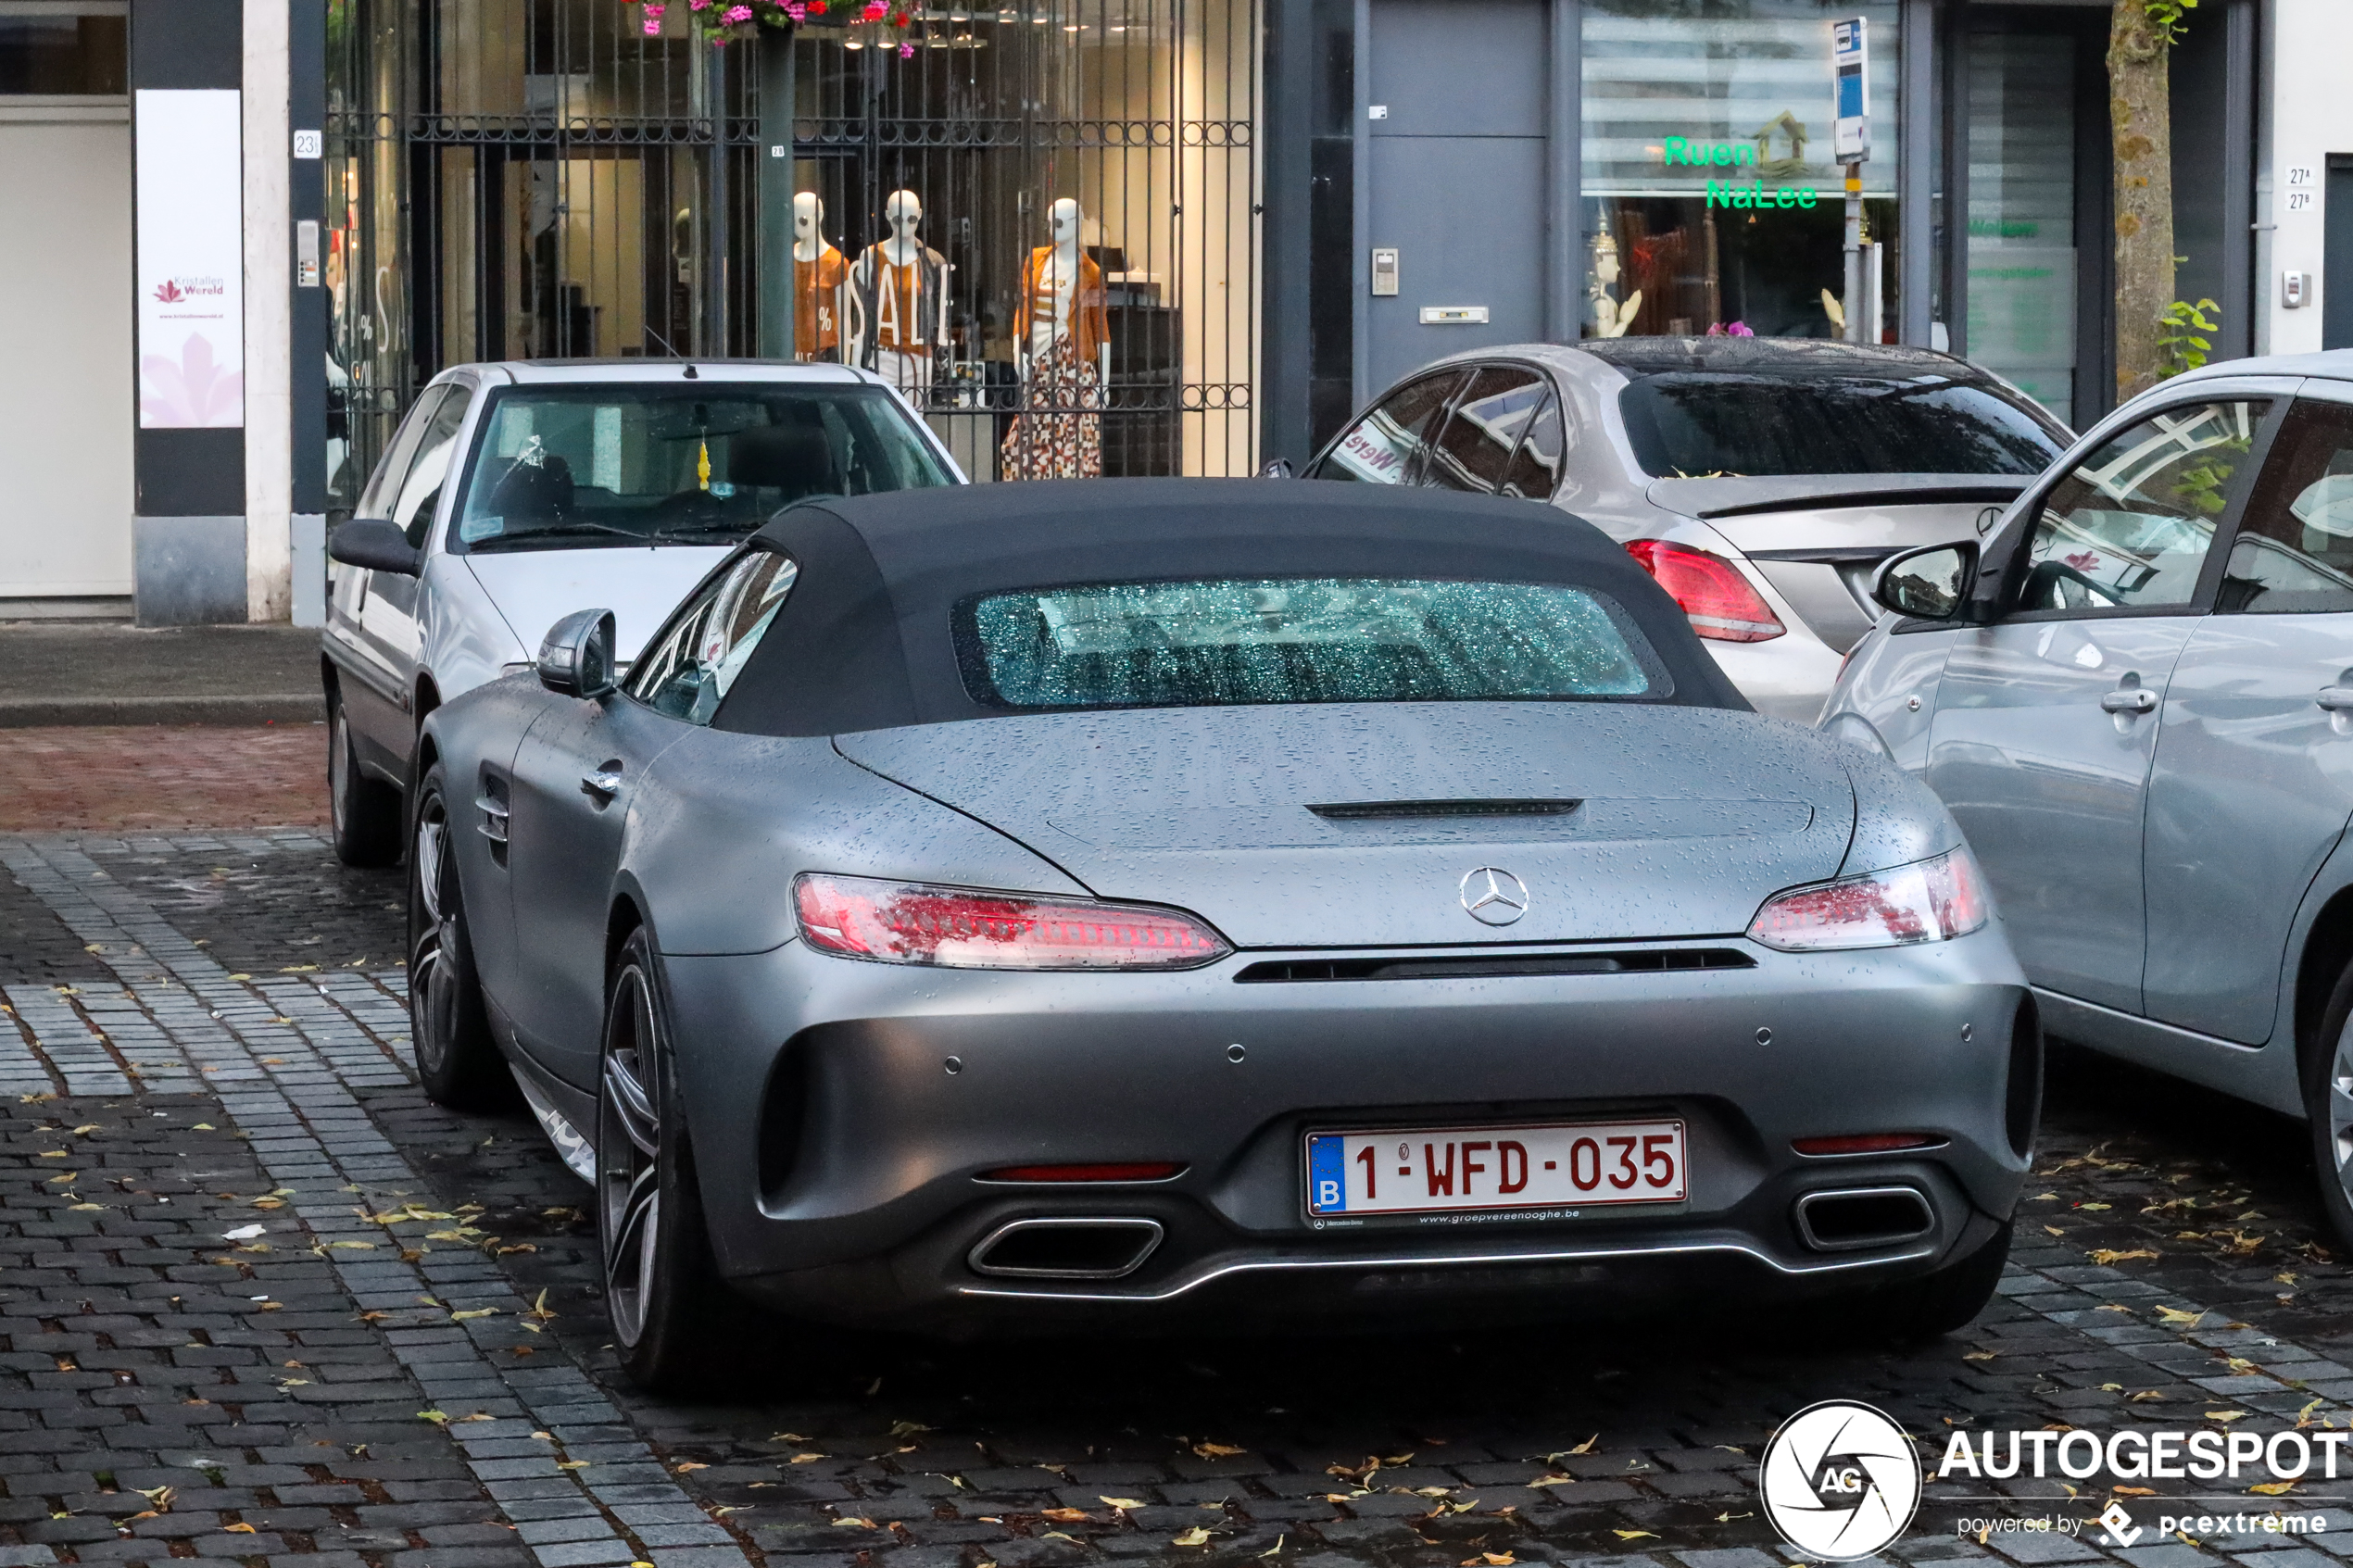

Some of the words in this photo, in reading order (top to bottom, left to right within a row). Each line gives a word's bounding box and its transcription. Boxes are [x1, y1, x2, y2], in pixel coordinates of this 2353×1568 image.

[296, 135, 314, 153] 23
[1665, 135, 1754, 166] Ruen
[1706, 179, 1817, 208] NaLee
[174, 275, 223, 285] Kristallen
[184, 284, 223, 295] Wereld
[846, 259, 956, 346] SALE
[1319, 1180, 1340, 1205] B
[1356, 1135, 1675, 1199] 1-WFD-035
[1419, 1209, 1580, 1224] www.groepvereenooghe.be
